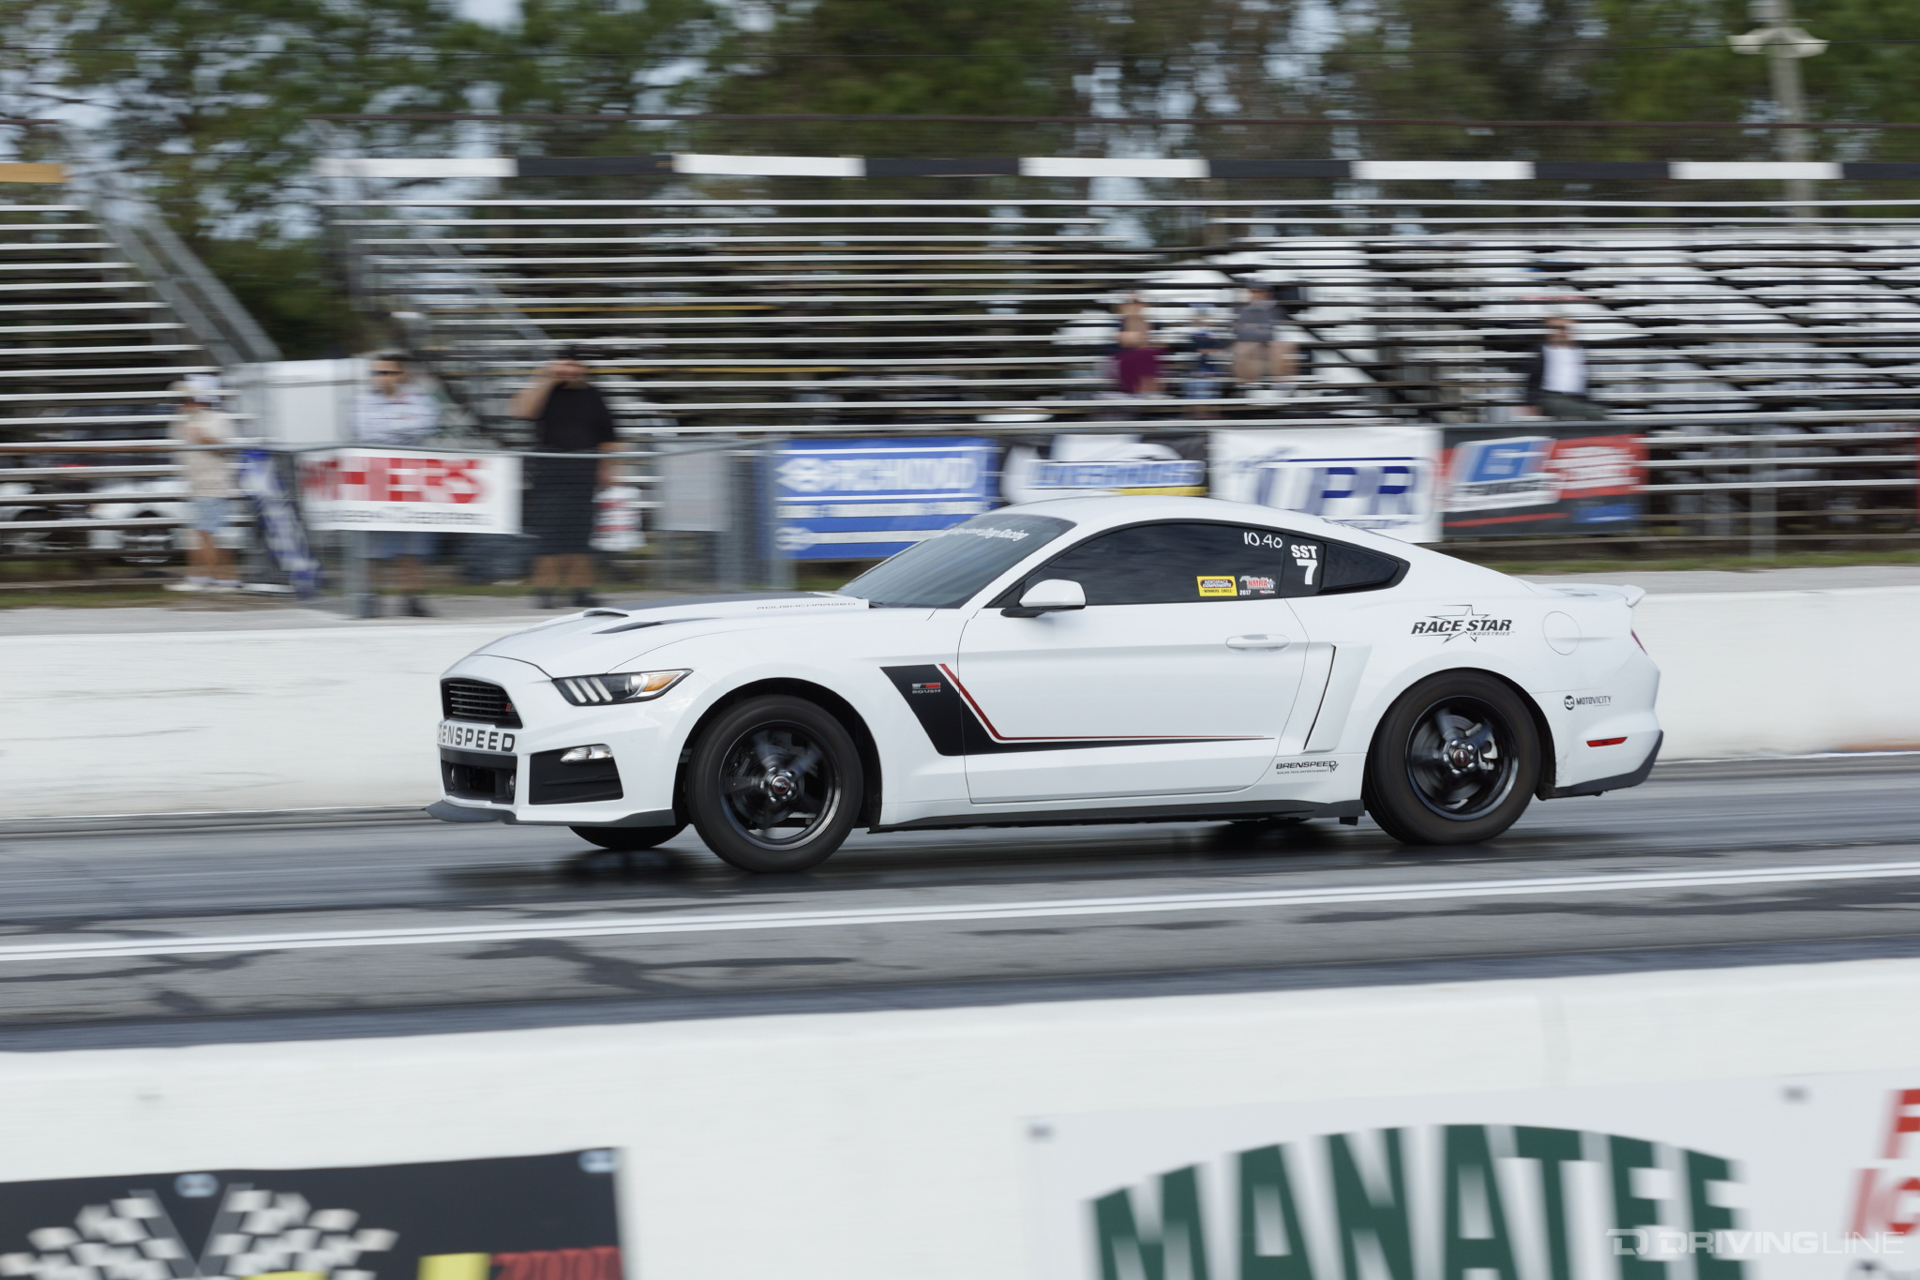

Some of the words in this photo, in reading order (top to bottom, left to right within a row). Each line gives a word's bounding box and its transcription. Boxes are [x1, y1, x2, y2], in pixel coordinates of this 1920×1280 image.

[1243, 531, 1283, 549] 10.40
[1290, 544, 1318, 559] SST
[1296, 558, 1318, 585] 7
[1411, 620, 1464, 635] RACE
[1466, 619, 1512, 632] STAR
[1576, 695, 1612, 706] MOTOVICITY
[1276, 760, 1337, 770] BRENSPEED
